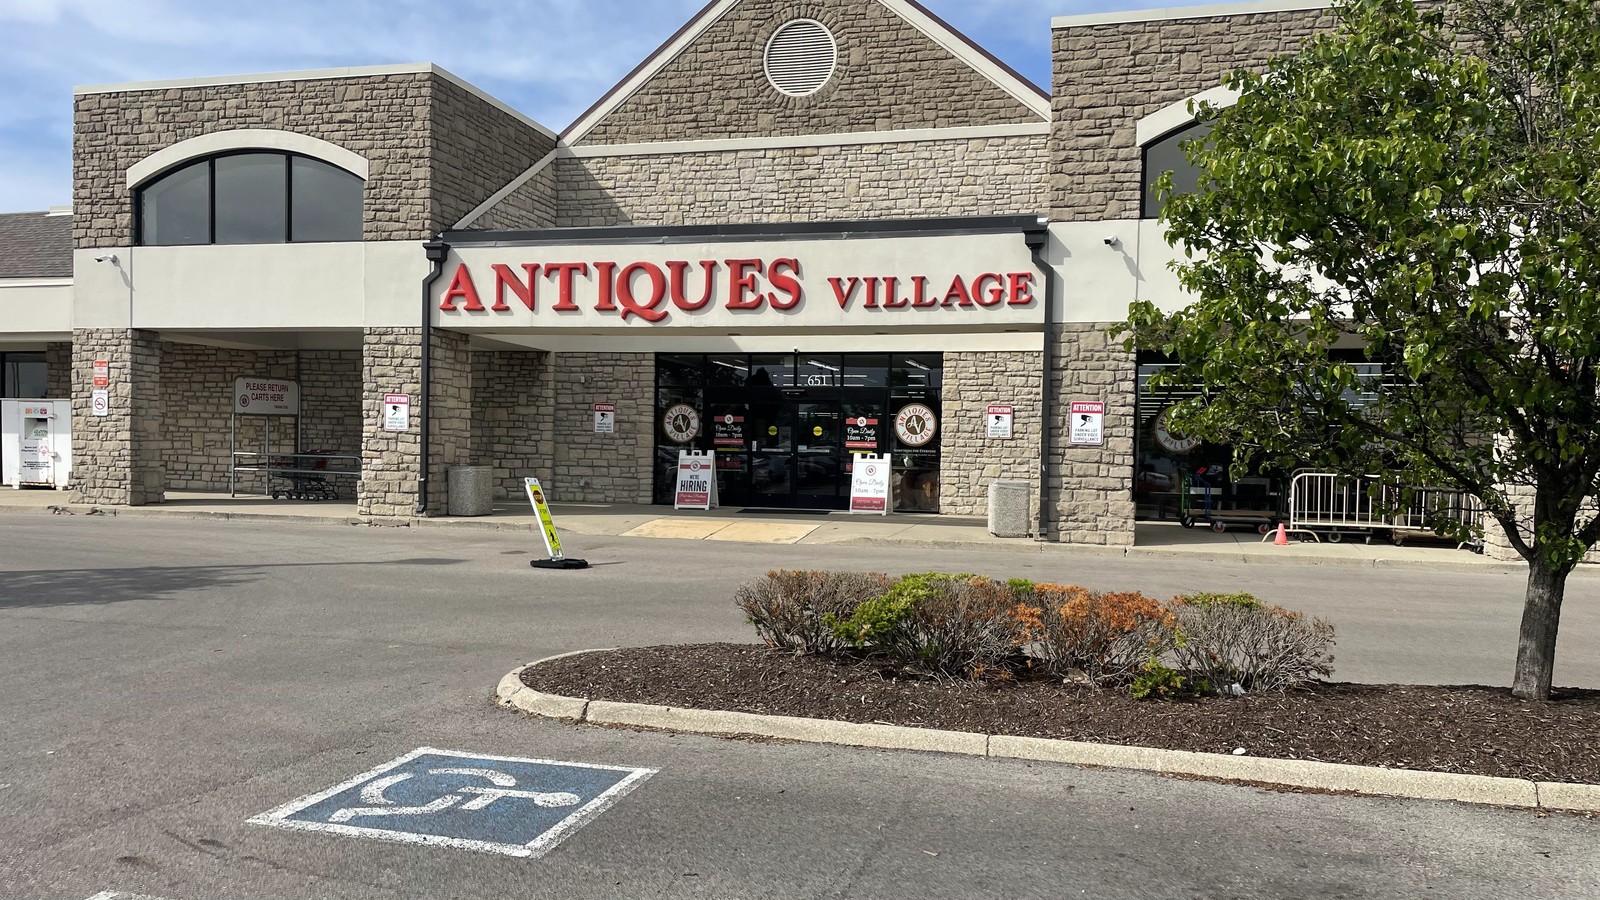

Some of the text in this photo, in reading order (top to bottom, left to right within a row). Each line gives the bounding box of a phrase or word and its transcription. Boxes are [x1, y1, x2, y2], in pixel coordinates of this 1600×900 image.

[439, 257, 1033, 323] ANTIQUES VILLAGE
[808, 375, 827, 386] 651
[246, 382, 288, 392] PLEASE RETURN
[251, 393, 269, 401] CARTS
[666, 407, 697, 425] ANTIQUES
[899, 408, 932, 427] ANTIQUES
[670, 426, 696, 440] VILLAGE
[727, 425, 742, 433] Daily
[860, 427, 875, 436] Daily
[902, 427, 932, 442] VILLAGE
[680, 480, 707, 492] HIRING
[856, 479, 884, 487] Open Daily
